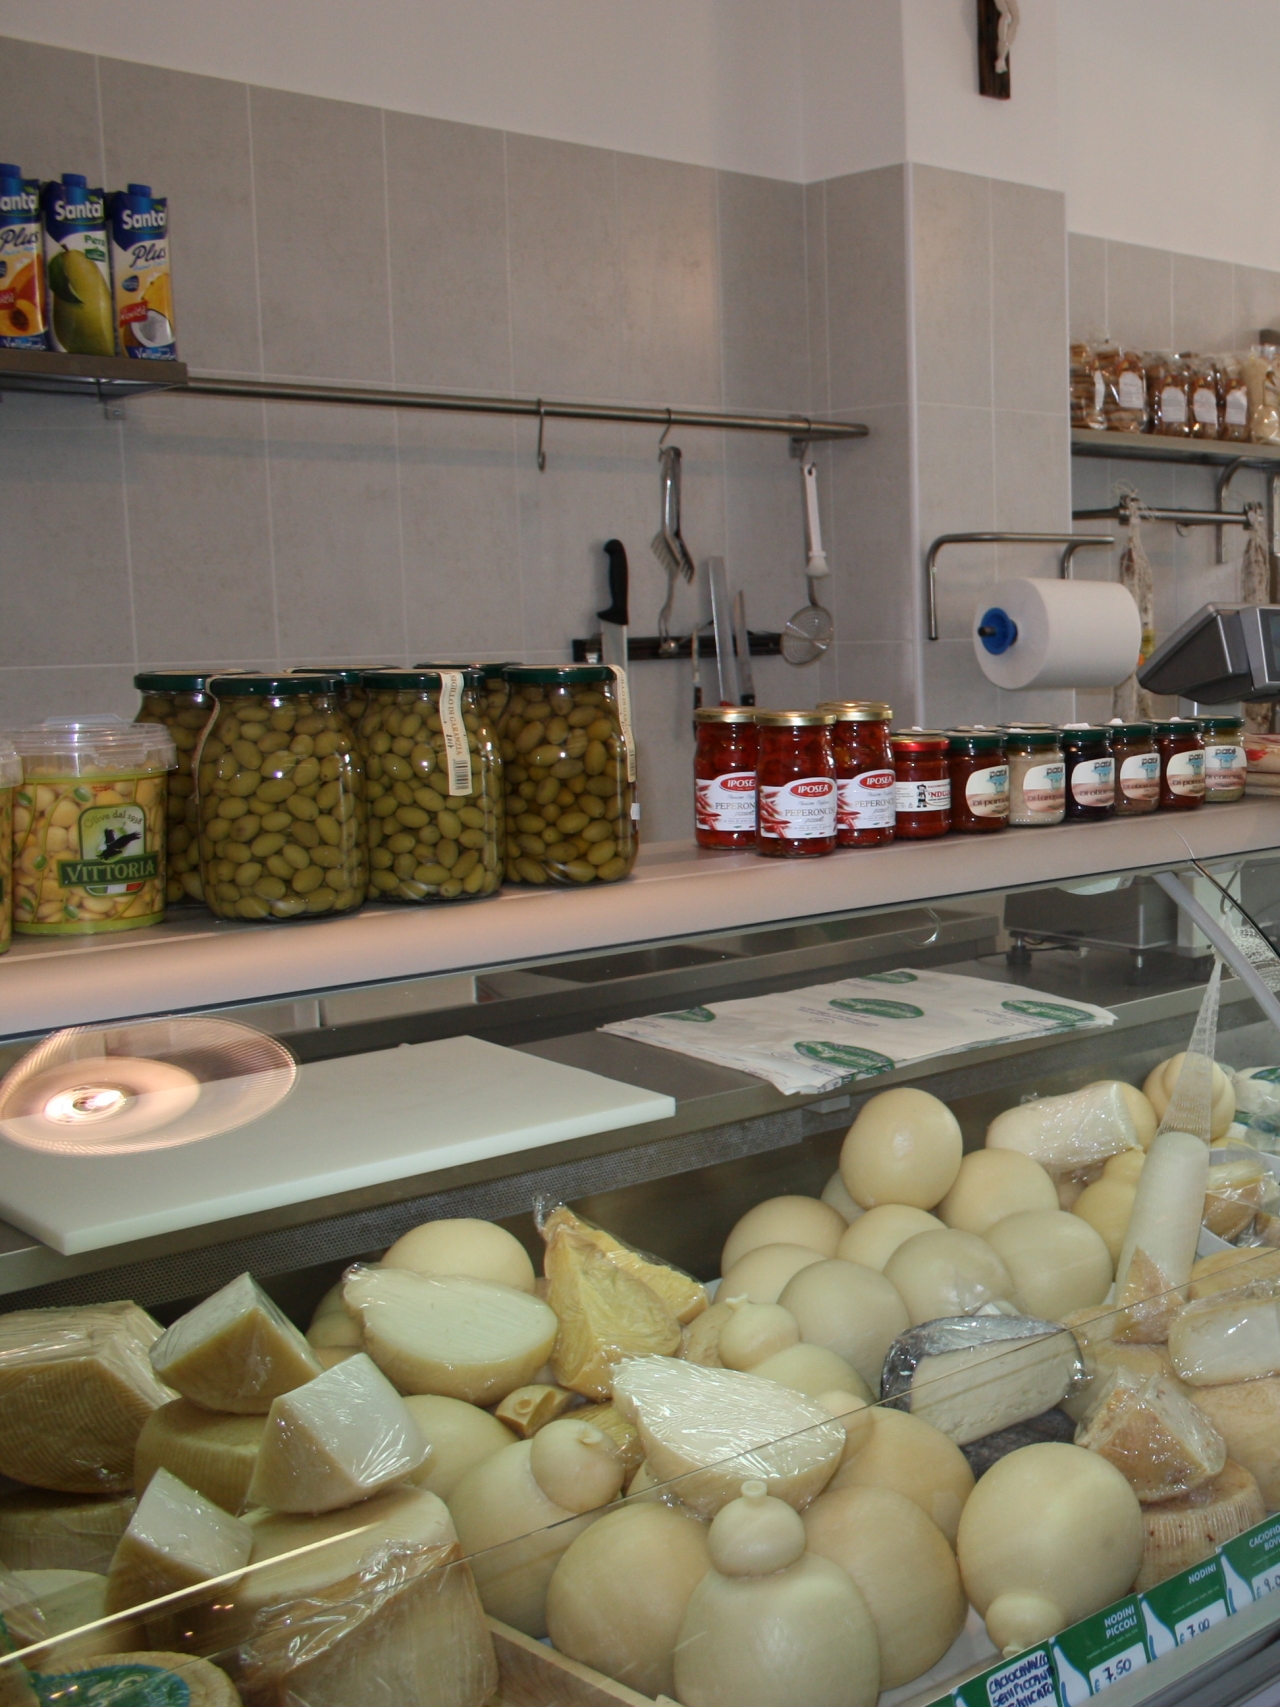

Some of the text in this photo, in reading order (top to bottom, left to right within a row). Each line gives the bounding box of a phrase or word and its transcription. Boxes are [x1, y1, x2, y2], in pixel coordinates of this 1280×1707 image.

[129, 243, 167, 268] Plus
[727, 779, 756, 788] IPOSE
[797, 784, 829, 794] IPOSEA
[866, 776, 892, 785] IPOSEA
[715, 801, 756, 810] PEPERON
[784, 806, 836, 817] PEPERONCIN
[83, 809, 144, 829] Olive dal 1938
[66, 860, 156, 884] VITTORIA
[1188, 1563, 1217, 1585] NODINI
[1104, 1605, 1135, 1628] NODINI
[1105, 1615, 1137, 1639] PICCOLI
[1186, 1618, 1211, 1638] 7.00
[1102, 1658, 1133, 1684] 7.50
